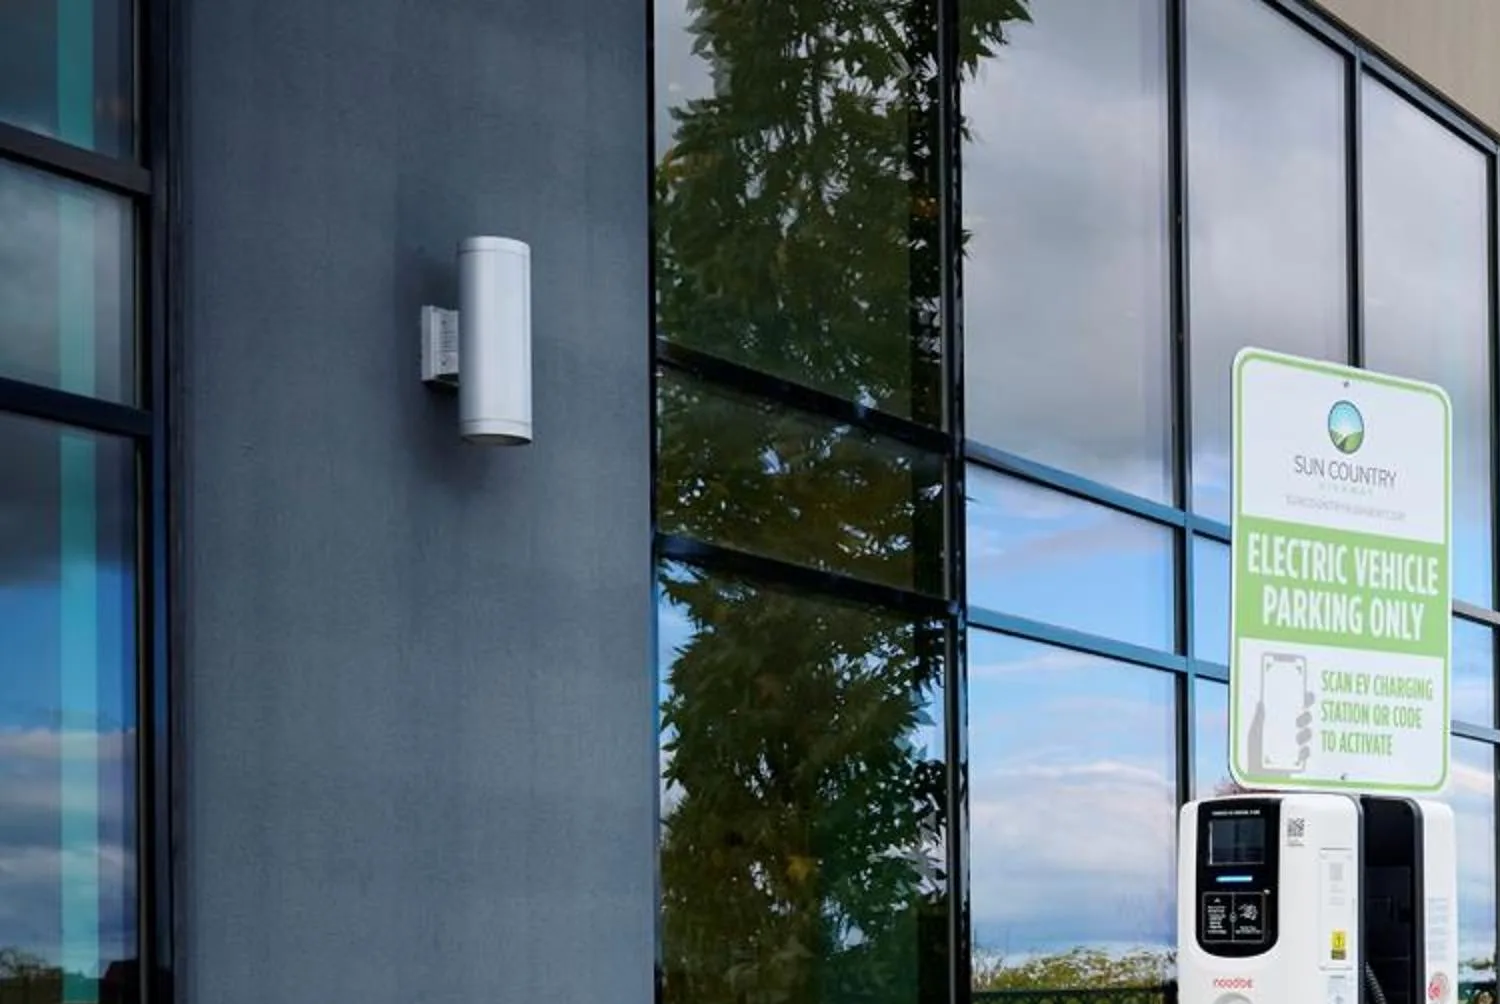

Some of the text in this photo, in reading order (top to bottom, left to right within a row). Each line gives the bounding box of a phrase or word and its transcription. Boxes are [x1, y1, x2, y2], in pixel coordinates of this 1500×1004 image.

[1294, 455, 1397, 489] SUN COUNTRY
[1247, 531, 1439, 596] ELECTRIC VEHICLE
[1263, 584, 1424, 641] PARKING ONLY
[1321, 670, 1433, 701] SCAN EV CHARGING
[1321, 700, 1370, 726] STATION
[1393, 705, 1422, 729] CODE
[1321, 729, 1393, 756] TO ACTIVATE
